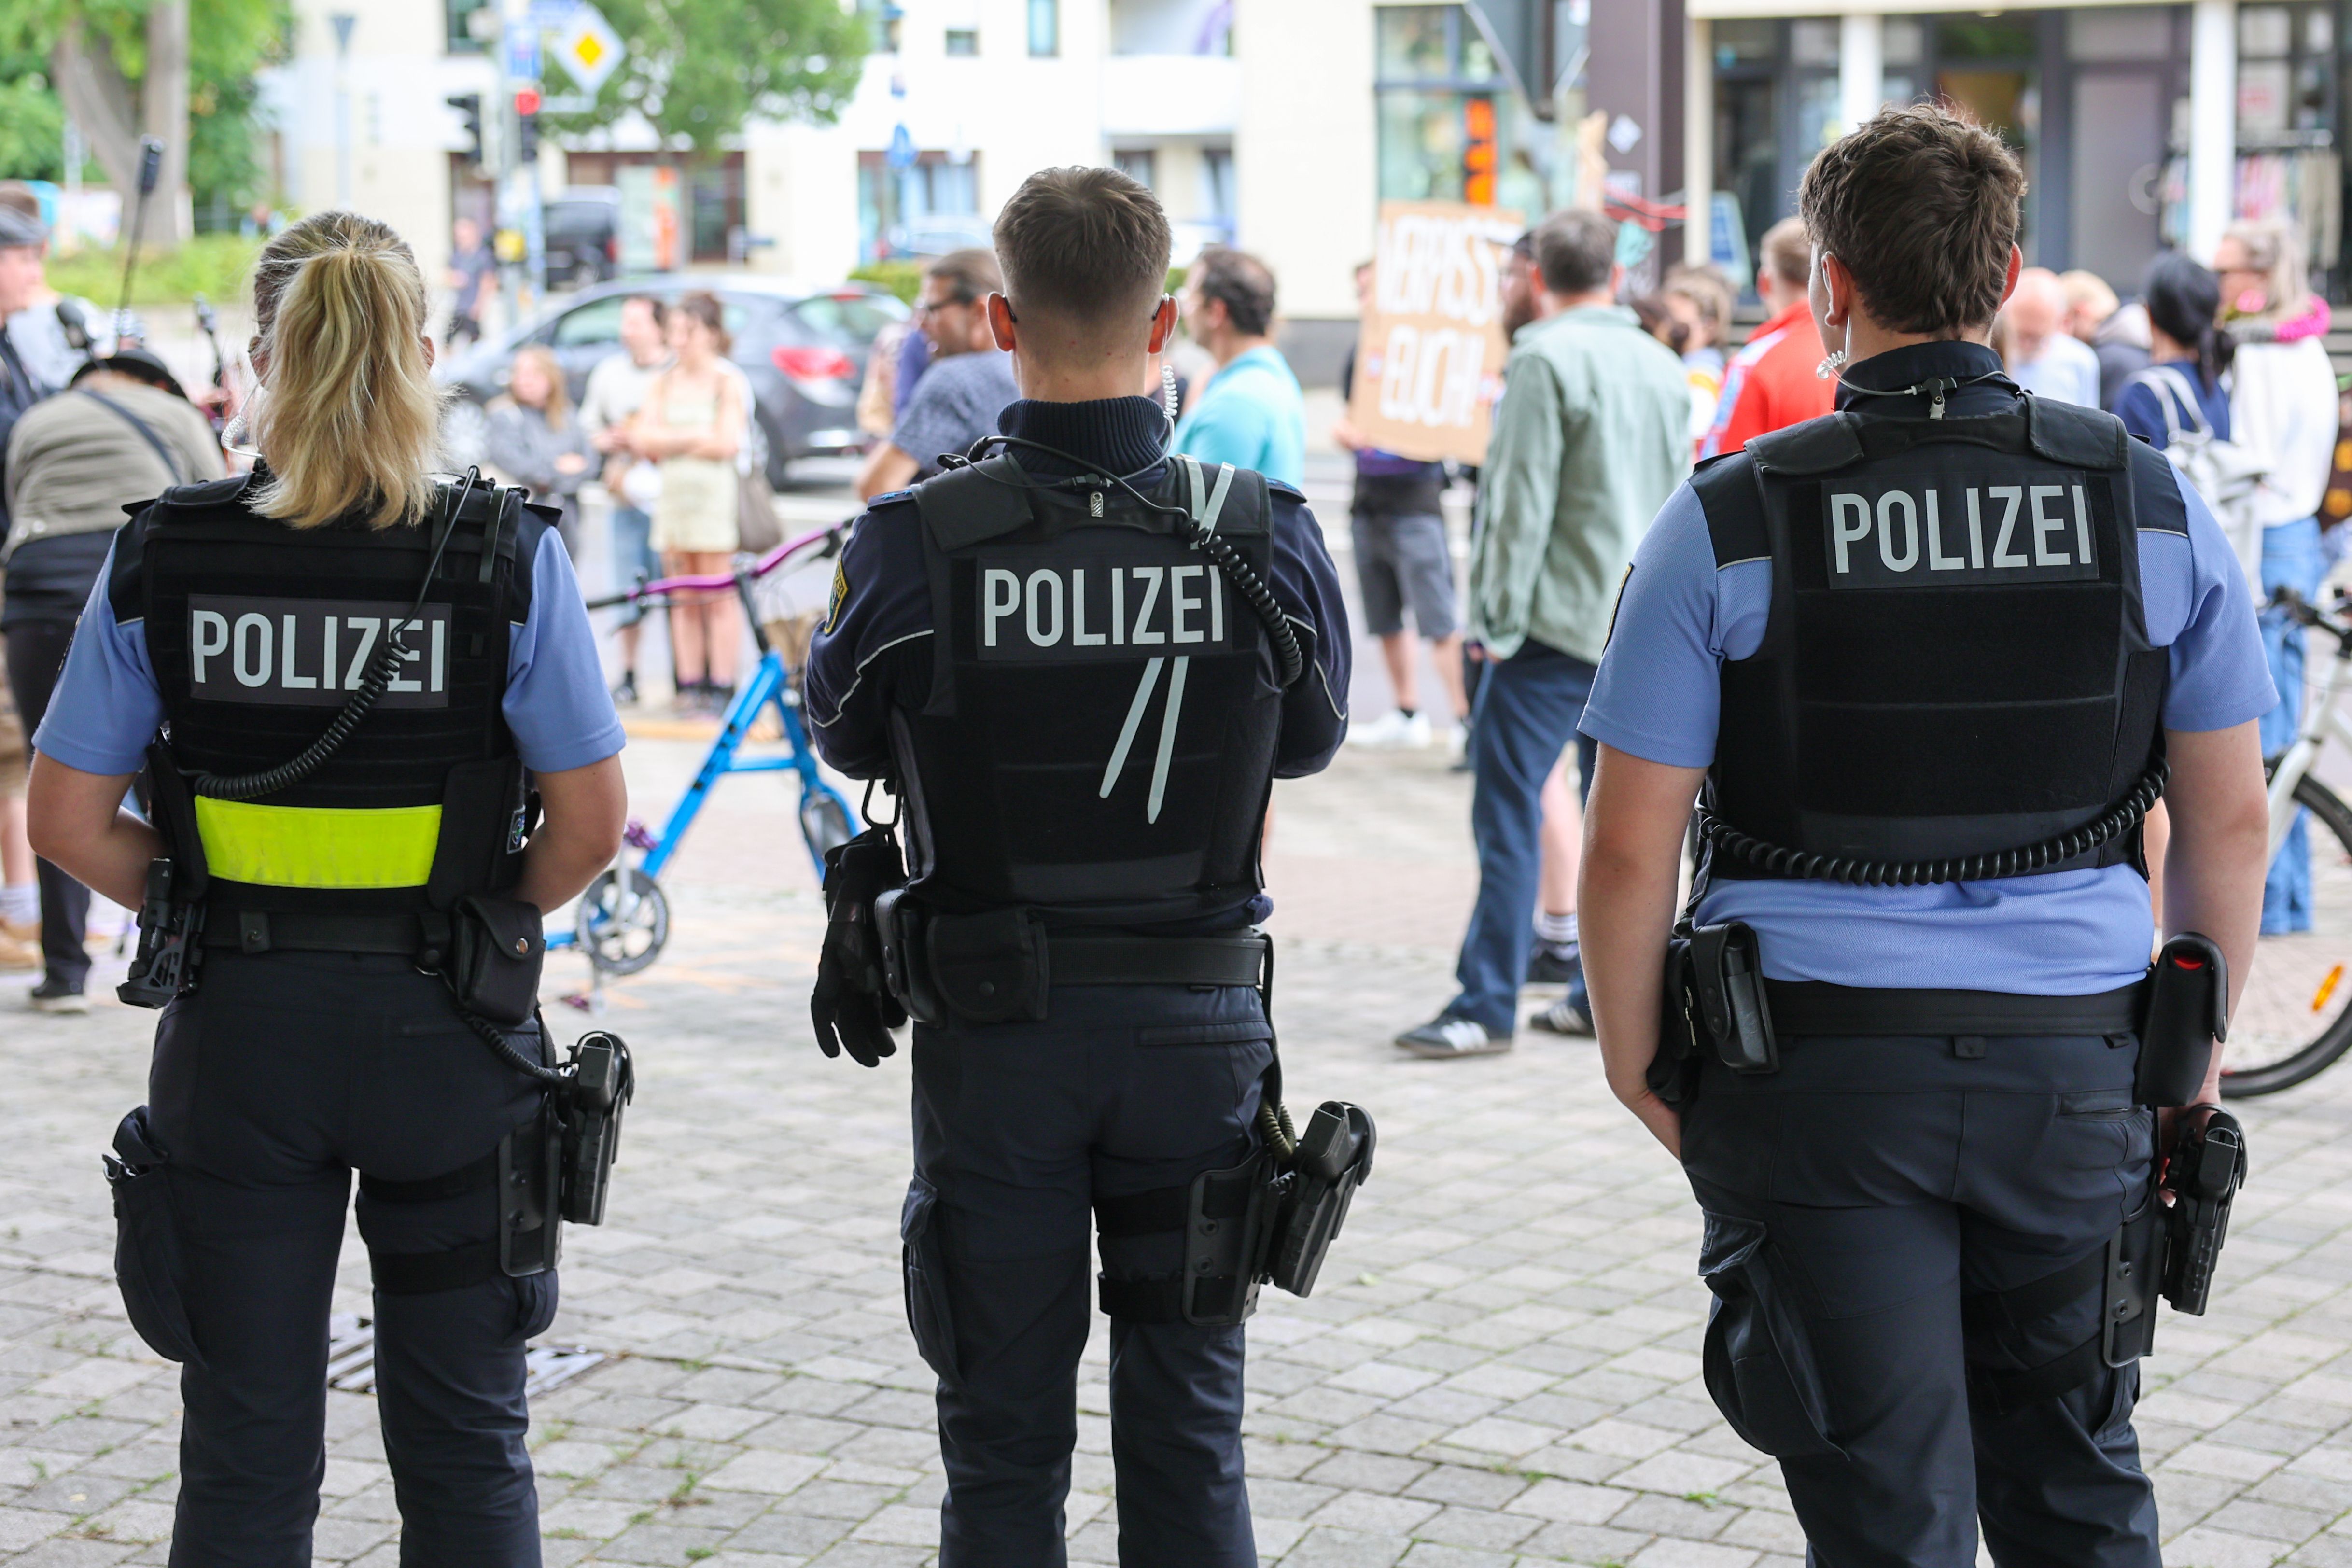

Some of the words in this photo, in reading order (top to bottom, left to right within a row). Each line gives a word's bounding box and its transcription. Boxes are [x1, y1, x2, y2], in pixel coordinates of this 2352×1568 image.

[1830, 485, 2092, 574] POLIZEI
[984, 565, 1224, 647] POLIZEI
[193, 609, 445, 692] POLIZEI
